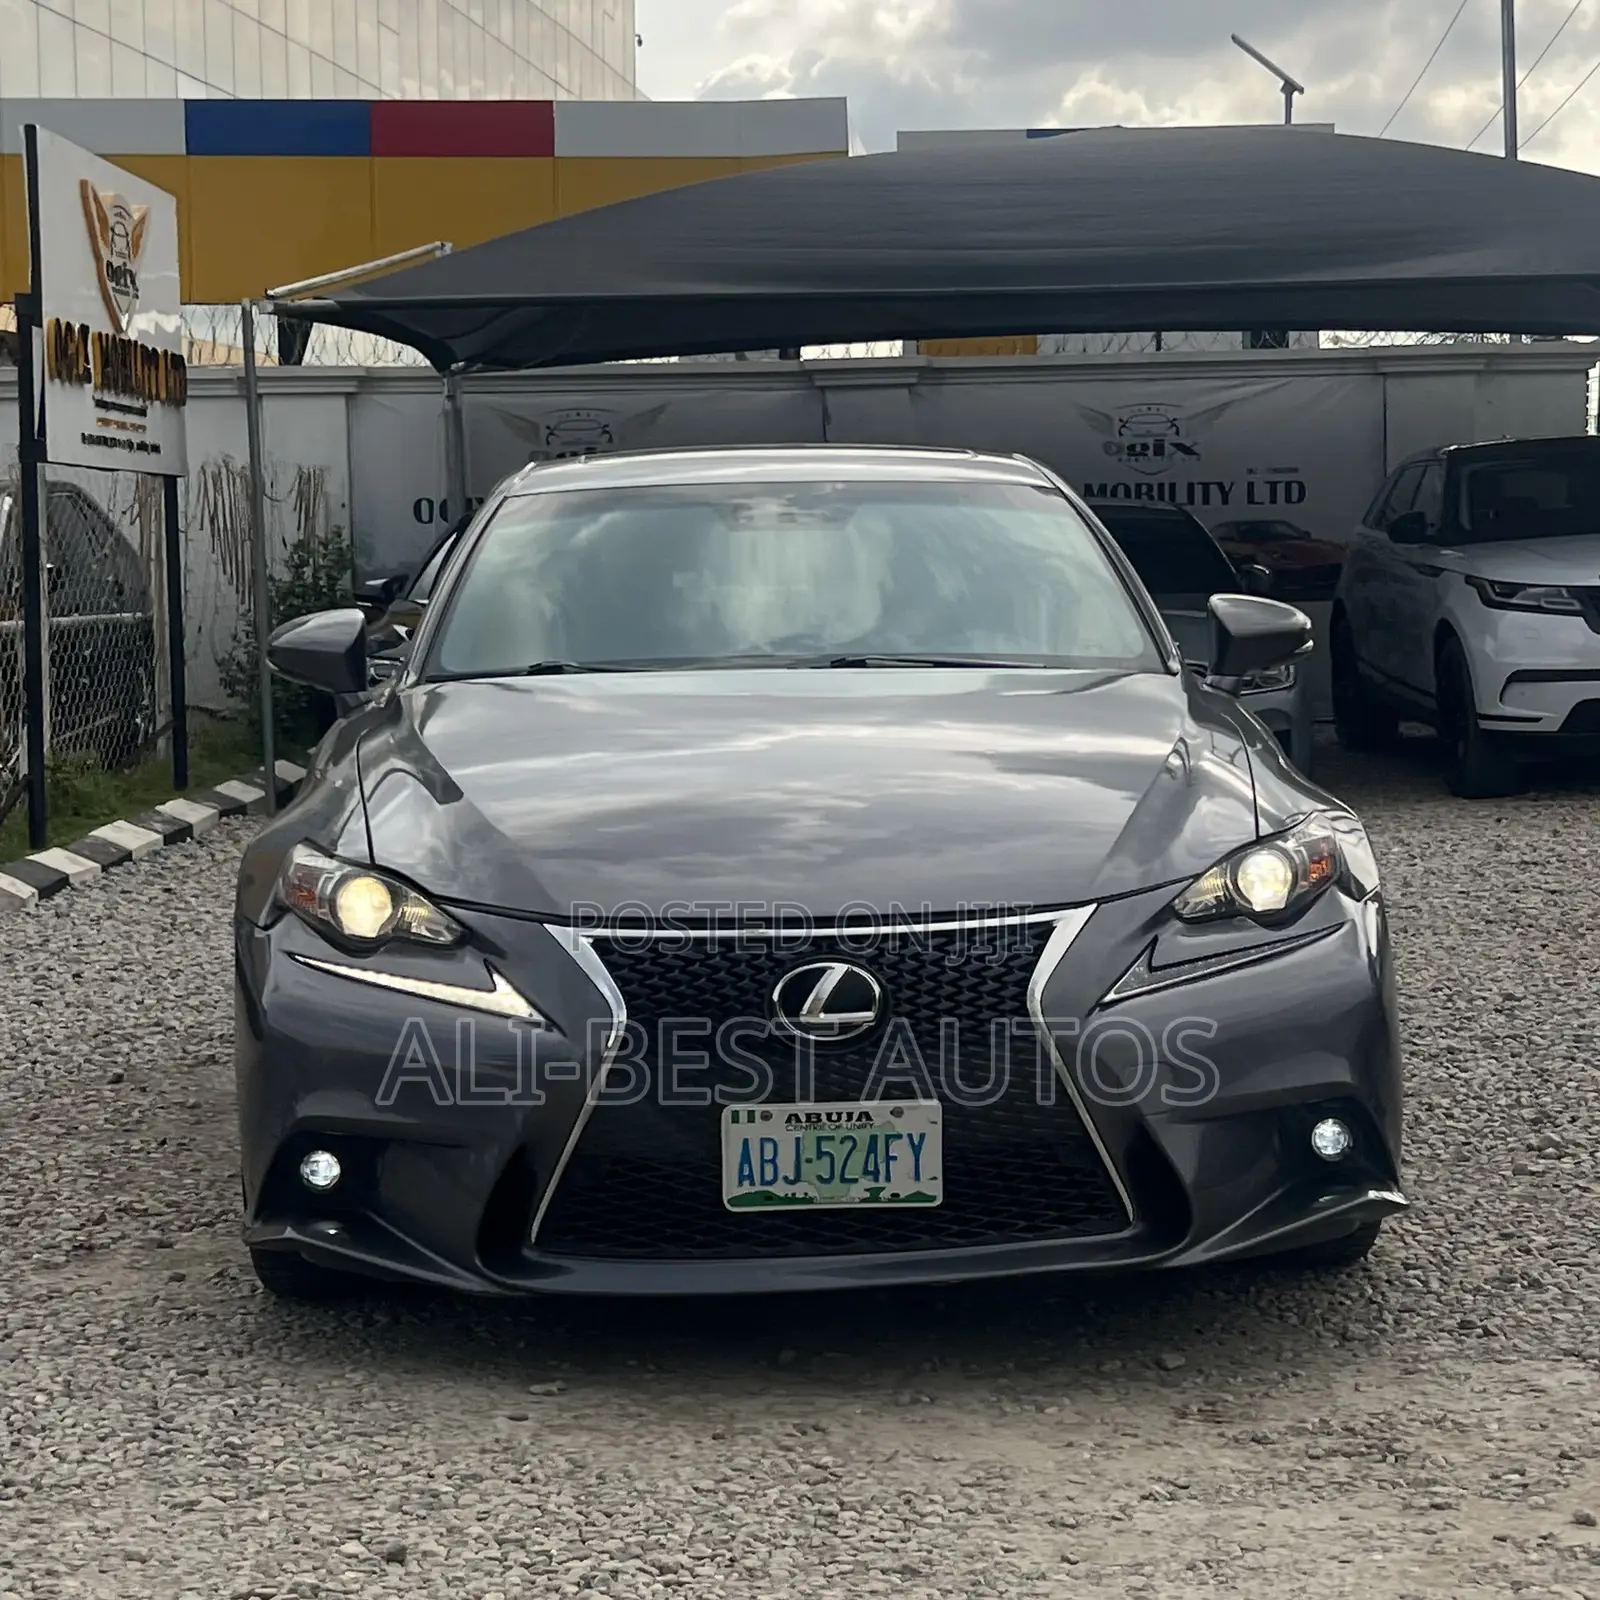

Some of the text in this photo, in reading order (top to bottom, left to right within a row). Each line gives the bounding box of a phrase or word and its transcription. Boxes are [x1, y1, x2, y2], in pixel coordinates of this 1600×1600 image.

[1084, 480, 1307, 506] MOBILITY LTD
[785, 1110, 874, 1124] ABUJA
[737, 1132, 926, 1187] ABJ-524FY
